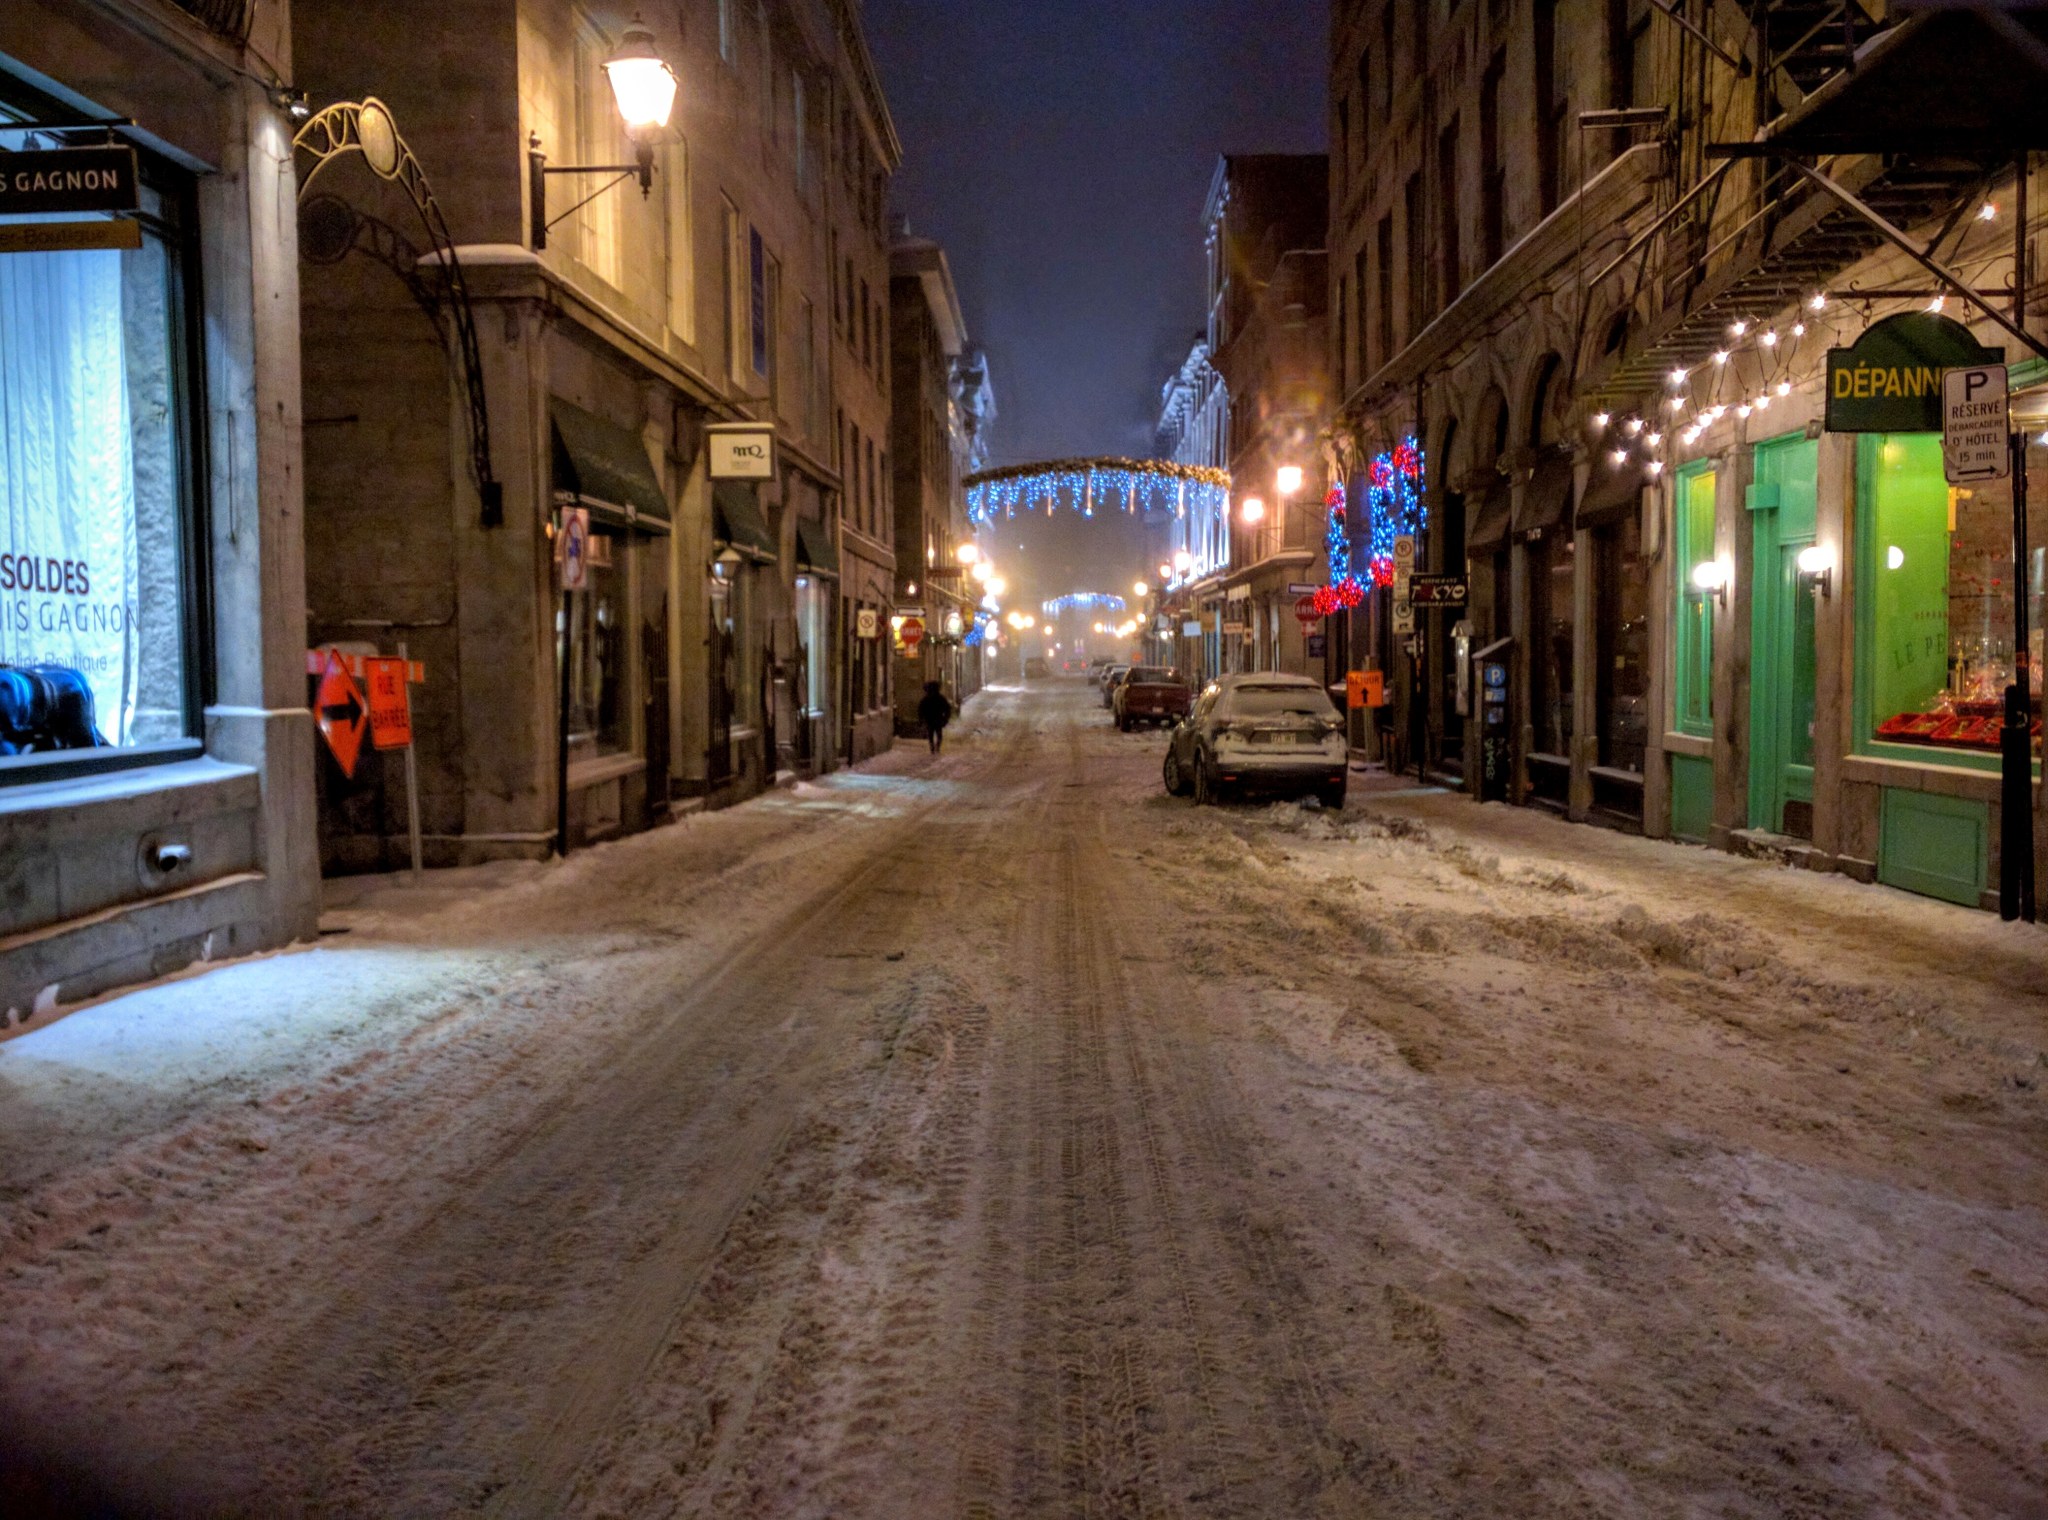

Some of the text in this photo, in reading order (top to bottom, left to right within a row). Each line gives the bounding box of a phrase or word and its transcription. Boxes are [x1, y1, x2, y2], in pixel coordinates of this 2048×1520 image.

[15, 169, 118, 192] GAGNON
[1835, 361, 1945, 398] DÉPANN
[1965, 371, 1989, 402] P
[1952, 400, 2000, 419] RÉSERVÉ
[1966, 432, 2000, 446] HÔTEL
[1960, 449, 1995, 463] 15 min
[1, 554, 90, 596] SOLDES
[0, 600, 141, 633] IS GAGNON
